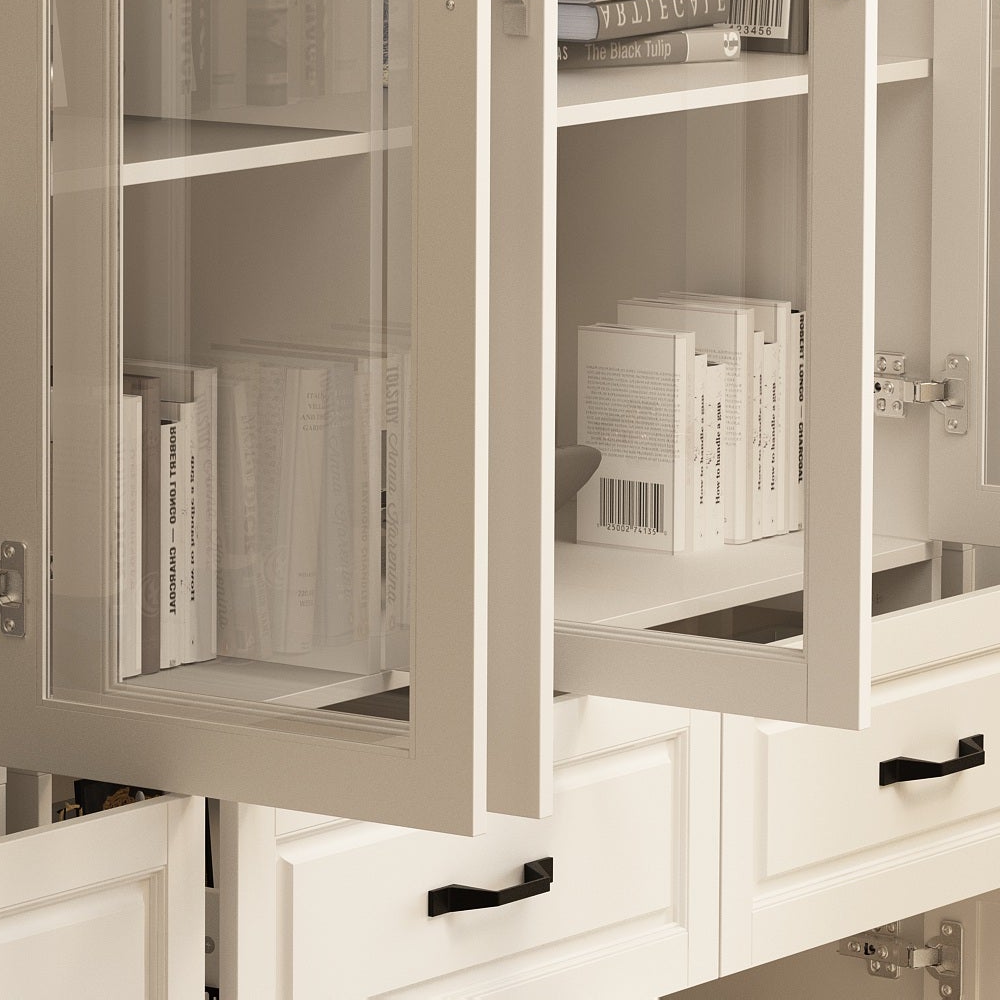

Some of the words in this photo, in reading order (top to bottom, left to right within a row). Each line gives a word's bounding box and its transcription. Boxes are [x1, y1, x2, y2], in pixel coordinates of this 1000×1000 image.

[585, 43, 606, 61] The
[610, 41, 641, 59] Black
[644, 39, 672, 60] Tulip
[607, 523, 630, 533] 25002
